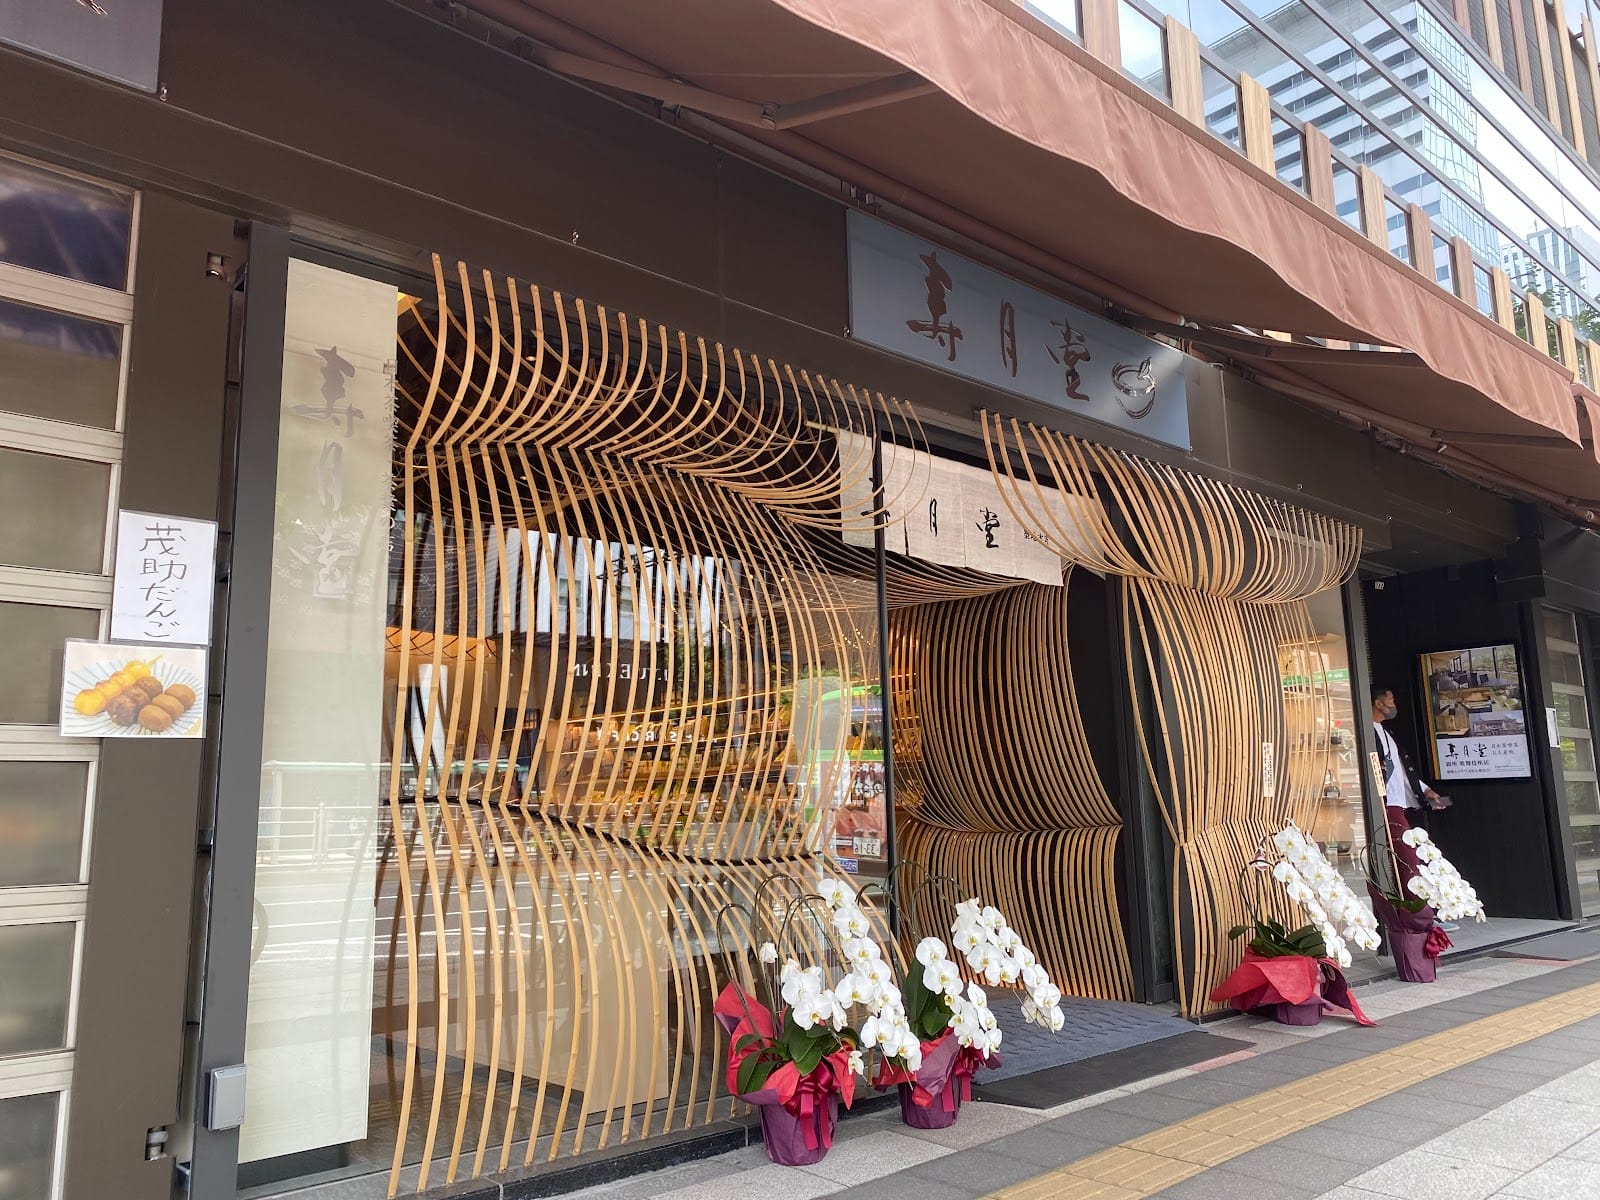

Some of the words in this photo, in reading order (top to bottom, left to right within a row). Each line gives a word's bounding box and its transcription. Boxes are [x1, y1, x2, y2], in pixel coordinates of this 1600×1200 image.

[139, 522, 187, 637] 茂助だんご
